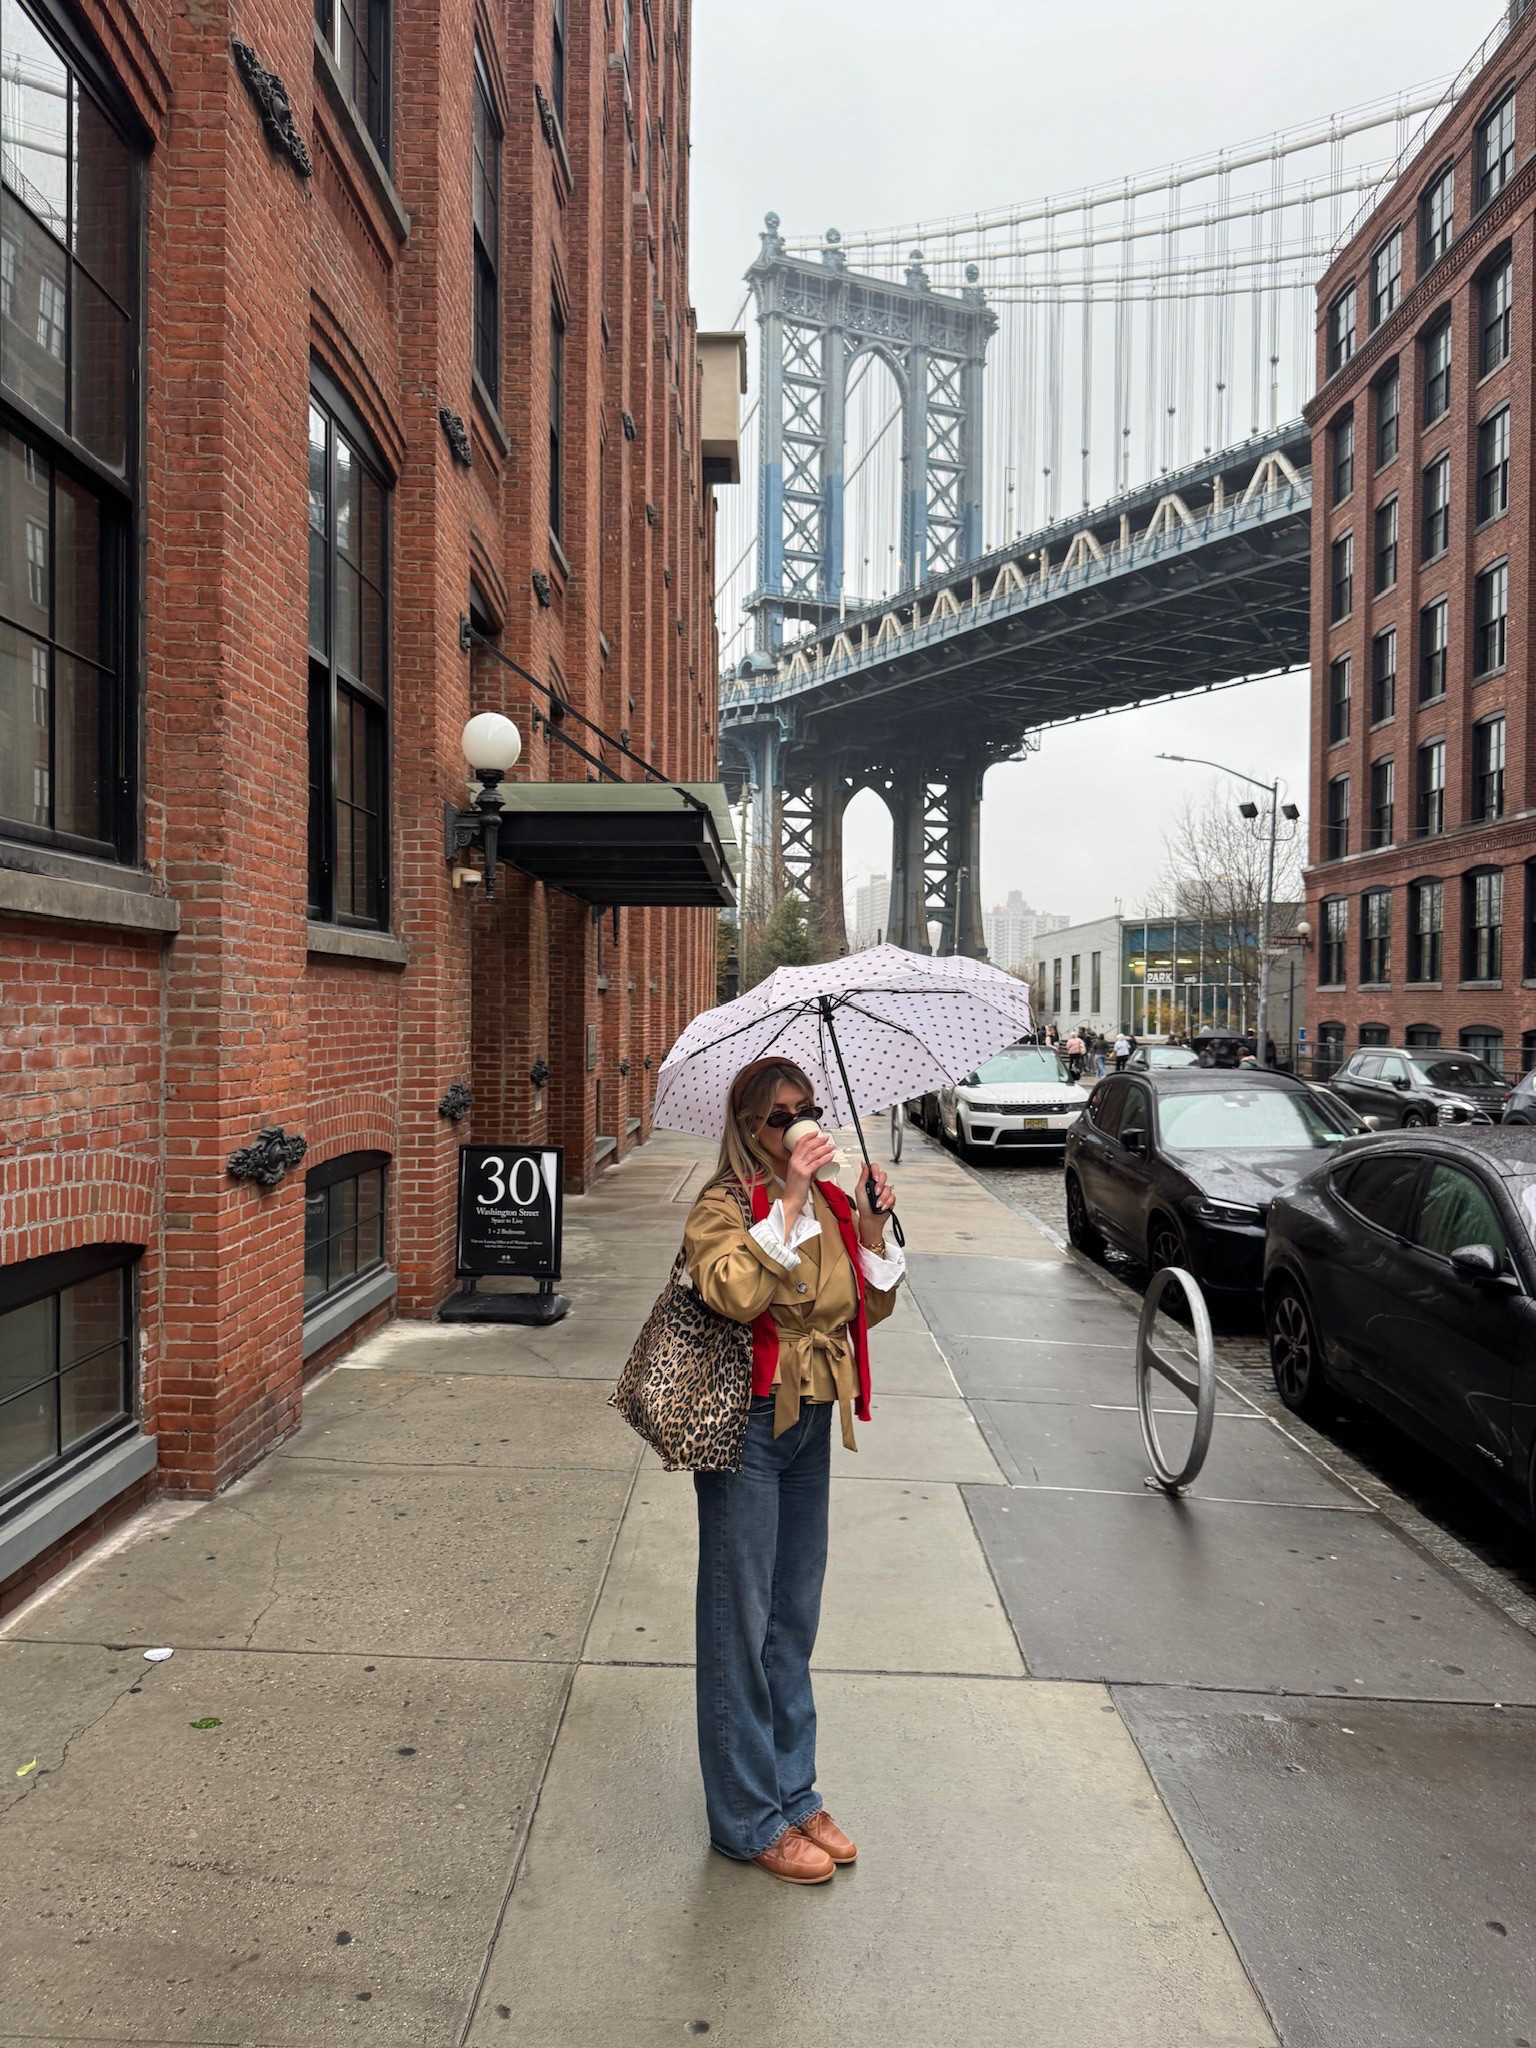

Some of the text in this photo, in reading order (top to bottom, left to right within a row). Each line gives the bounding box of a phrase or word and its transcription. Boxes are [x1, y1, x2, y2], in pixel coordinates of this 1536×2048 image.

[1146, 972, 1173, 984] PARK
[477, 1156, 540, 1206] 30
[476, 1207, 540, 1218] Washington Street
